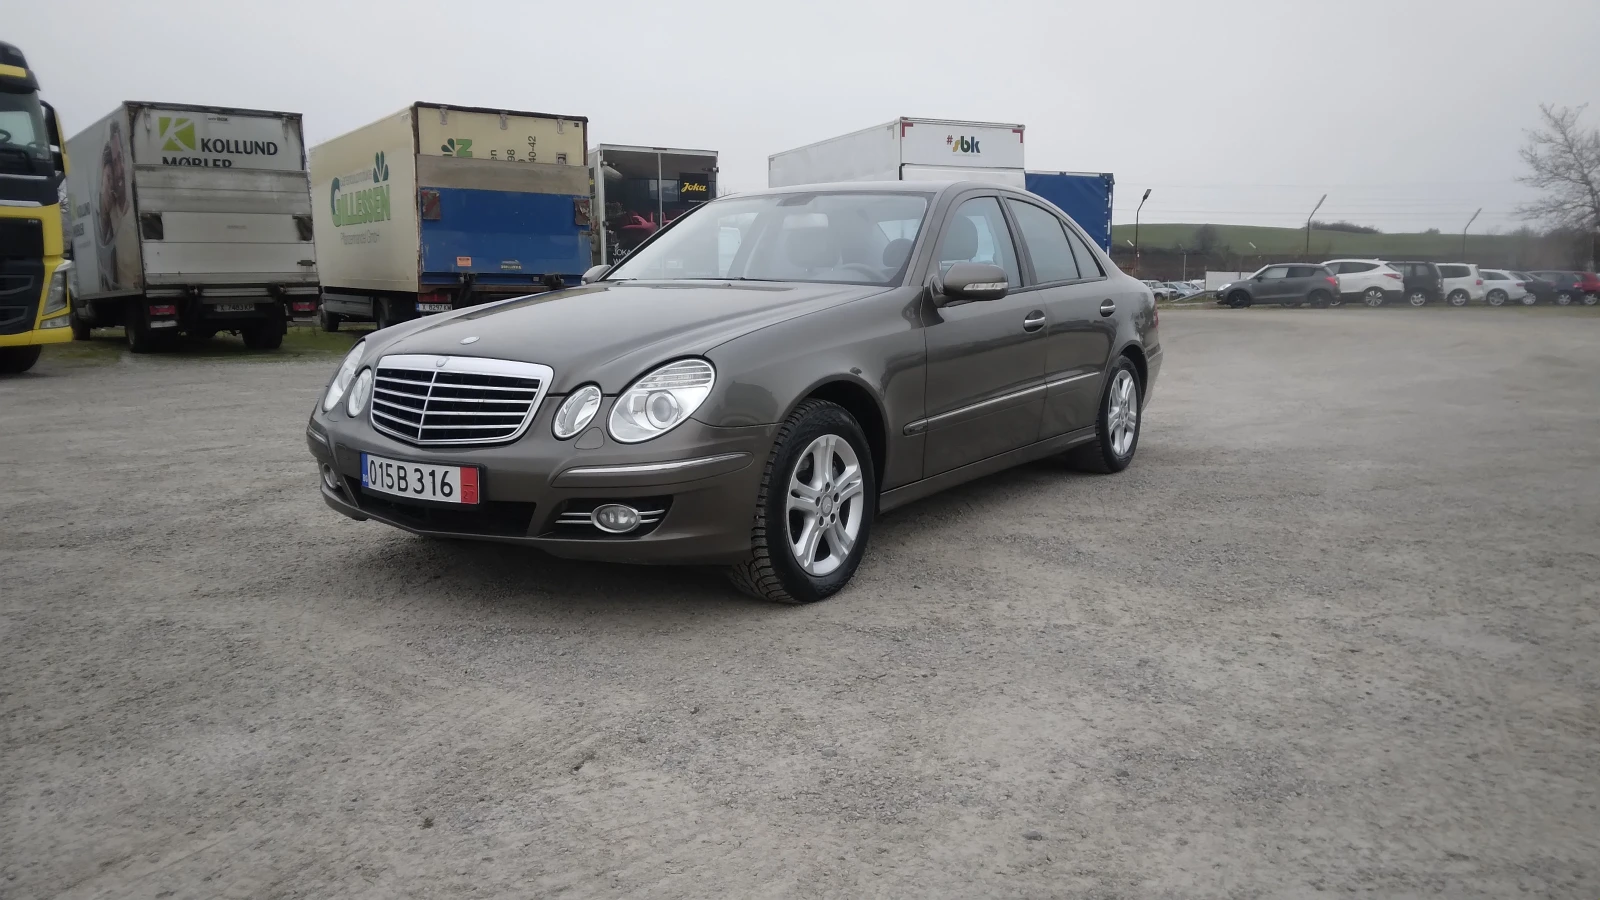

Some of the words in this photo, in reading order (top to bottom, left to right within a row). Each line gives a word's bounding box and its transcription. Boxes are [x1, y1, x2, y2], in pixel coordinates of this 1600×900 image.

[200, 137, 278, 156] KOLLUND
[681, 182, 708, 193] Joka
[330, 177, 391, 228] GILLESSEN
